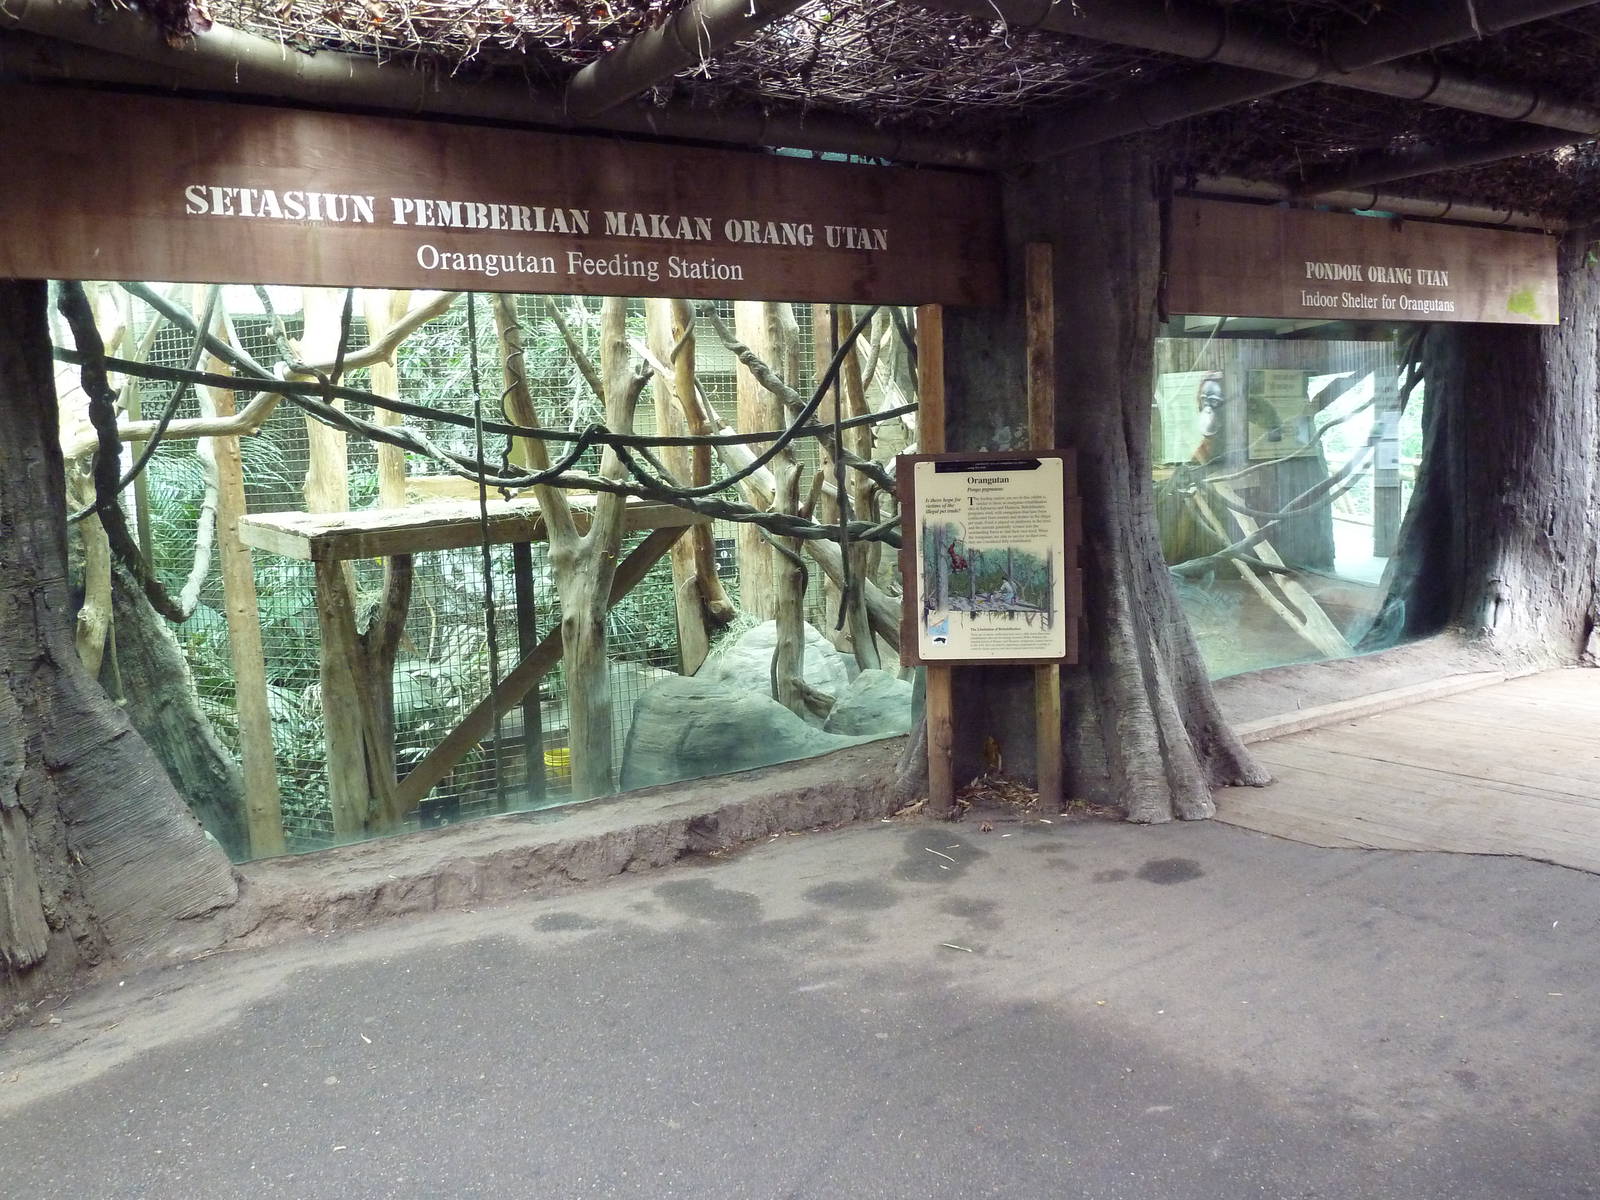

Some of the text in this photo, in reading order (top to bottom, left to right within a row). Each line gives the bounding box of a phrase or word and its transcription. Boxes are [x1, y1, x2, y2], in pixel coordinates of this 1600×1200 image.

[184, 185, 889, 250] SETASIUN PEMBERIAN MAKAN ORANG UTAN
[417, 244, 744, 282] Orangutan Feeding Station
[1305, 261, 1449, 287] PONDOK ORANG UTAN
[1301, 290, 1455, 314] Indoor Shelter for Orangutans
[967, 476, 1010, 485] Orangutan
